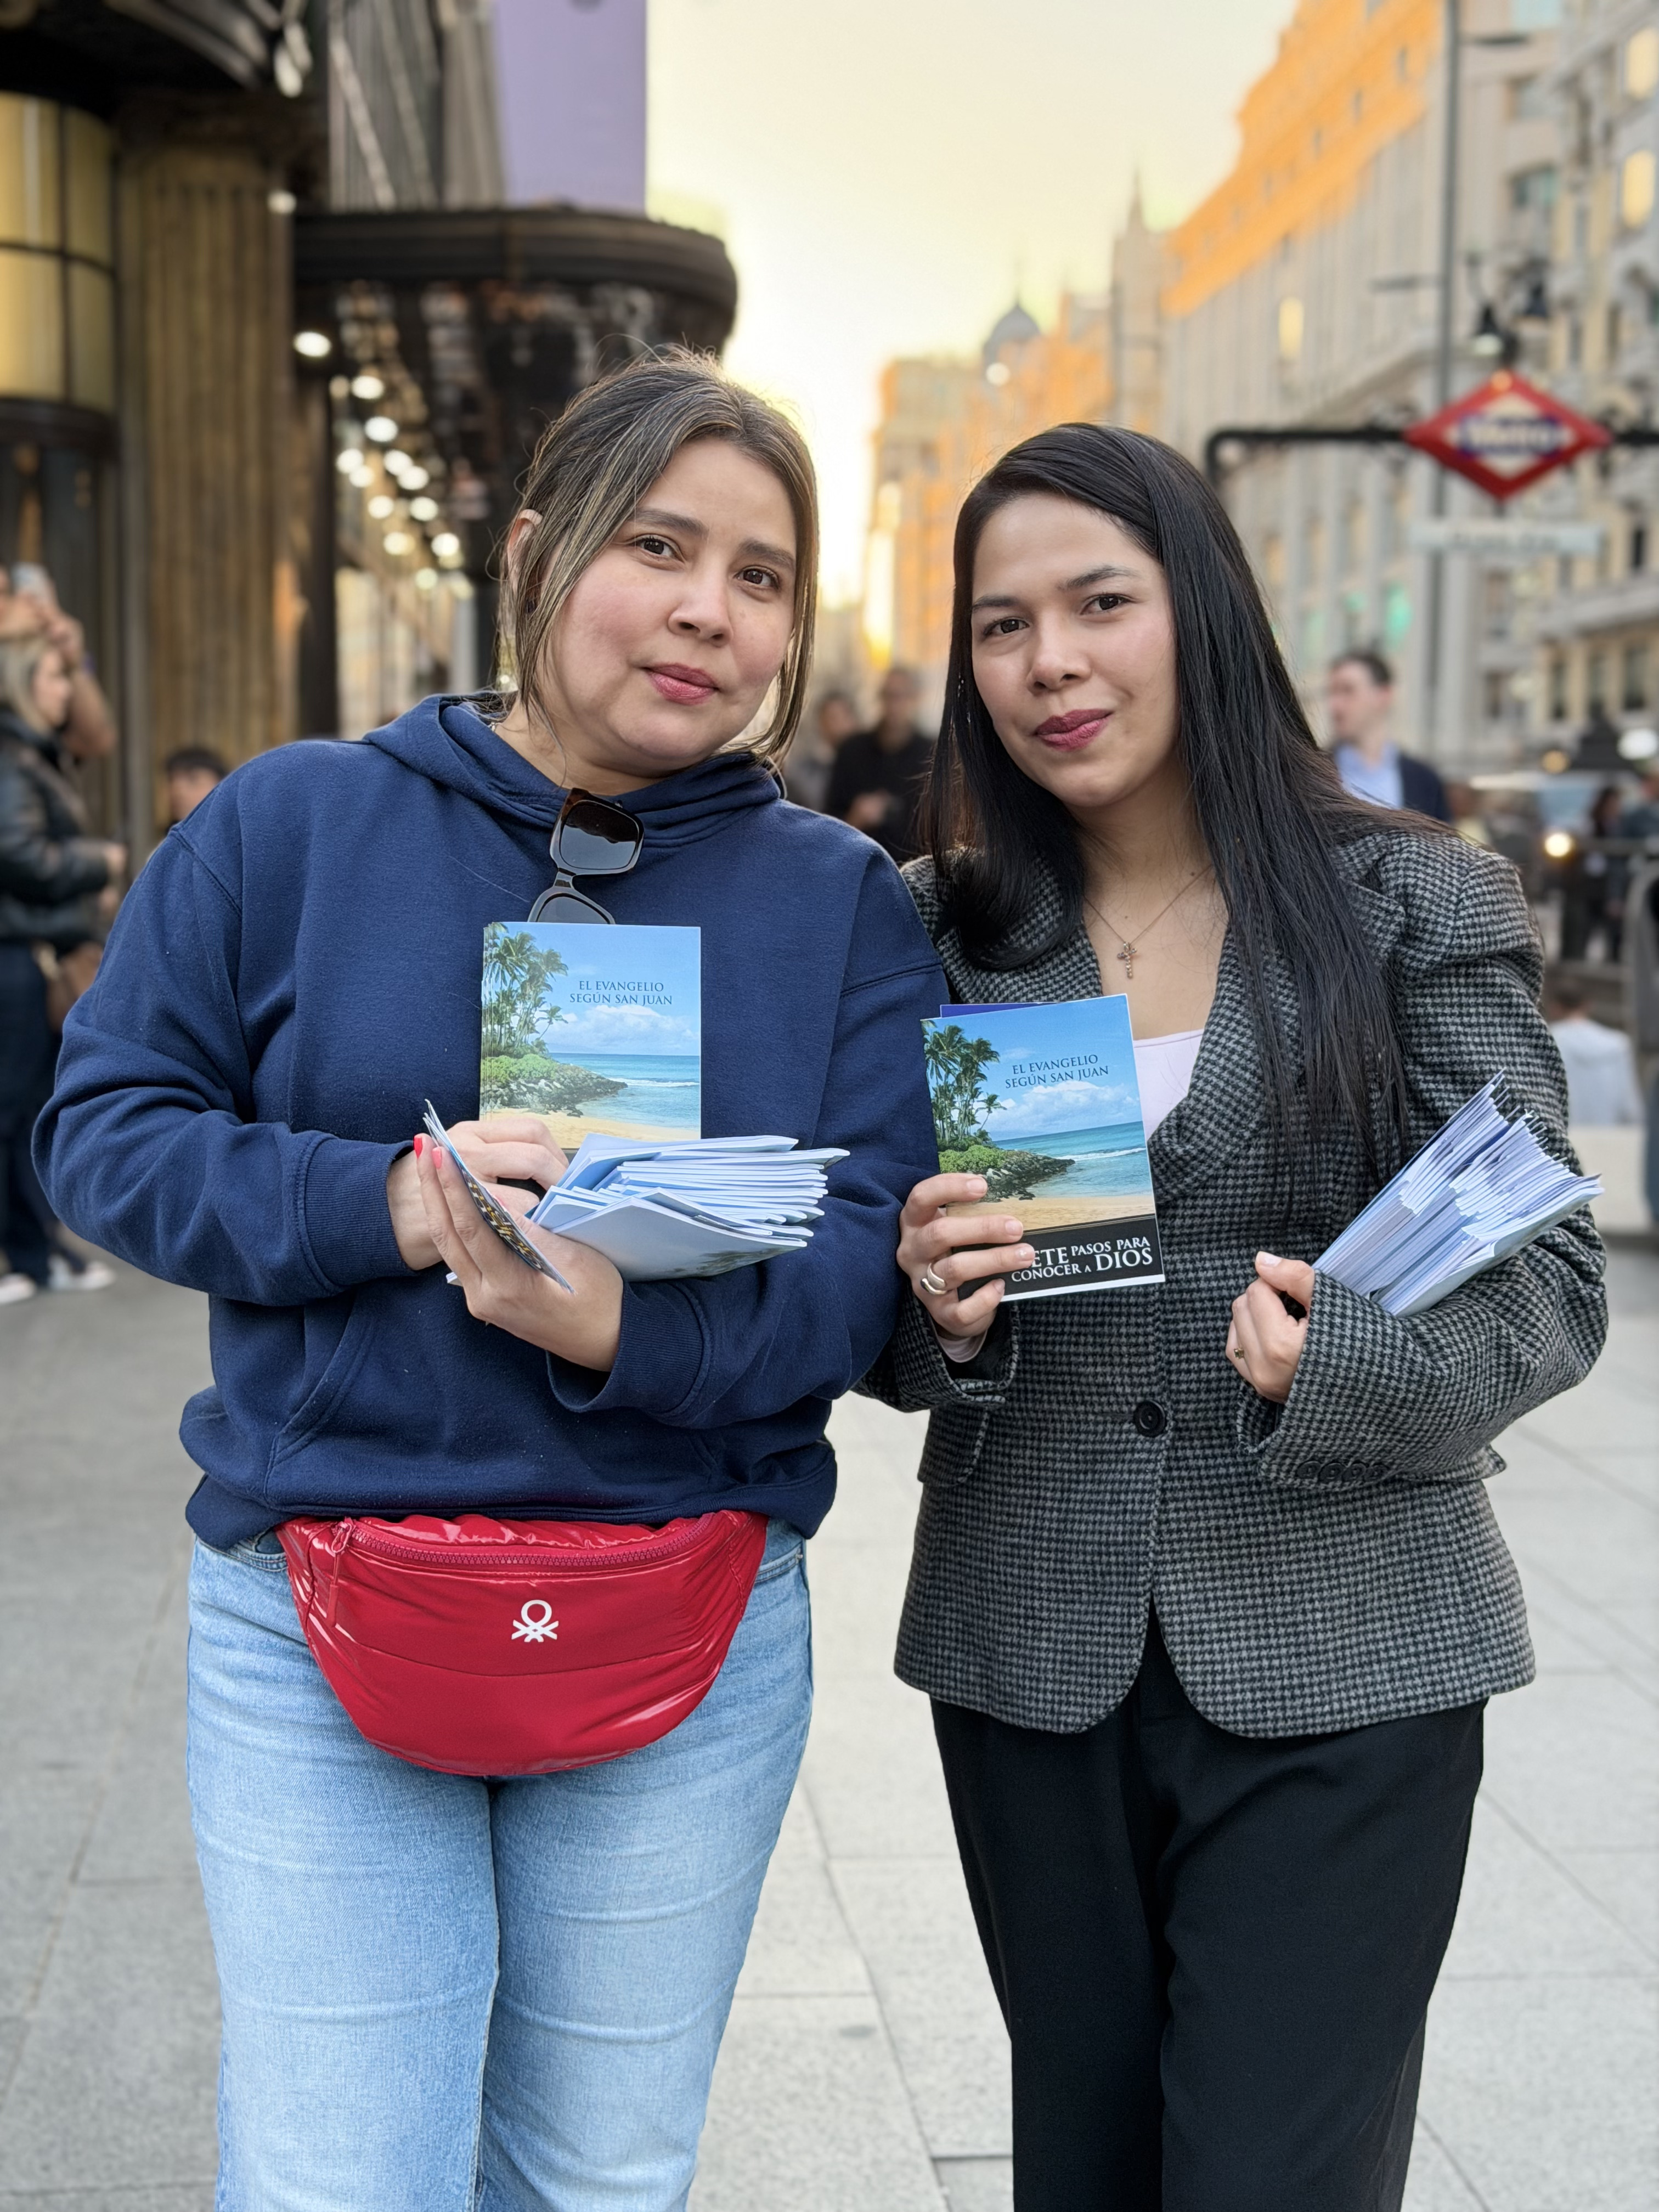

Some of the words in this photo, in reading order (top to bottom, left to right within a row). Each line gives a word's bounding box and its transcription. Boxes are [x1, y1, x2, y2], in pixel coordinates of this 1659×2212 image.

[579, 980, 591, 990] EL
[596, 981, 664, 992] EVANGELIO
[569, 992, 611, 1003] SEGÚN
[615, 994, 638, 1005] SAN
[642, 995, 673, 1006] JUAN
[1012, 1064, 1026, 1075] EL
[1029, 1054, 1098, 1073] EVANGELIO
[1005, 1074, 1047, 1089] SEGÚN
[1050, 1070, 1074, 1083] SAN
[1078, 1065, 1109, 1081] JUAN
[1031, 1246, 1069, 1268] ETE
[1071, 1241, 1111, 1257] PASOS
[1116, 1236, 1150, 1250] PARA
[1011, 1263, 1081, 1283] CONOCER
[1084, 1265, 1092, 1273] A
[1094, 1248, 1153, 1271] DIOS
